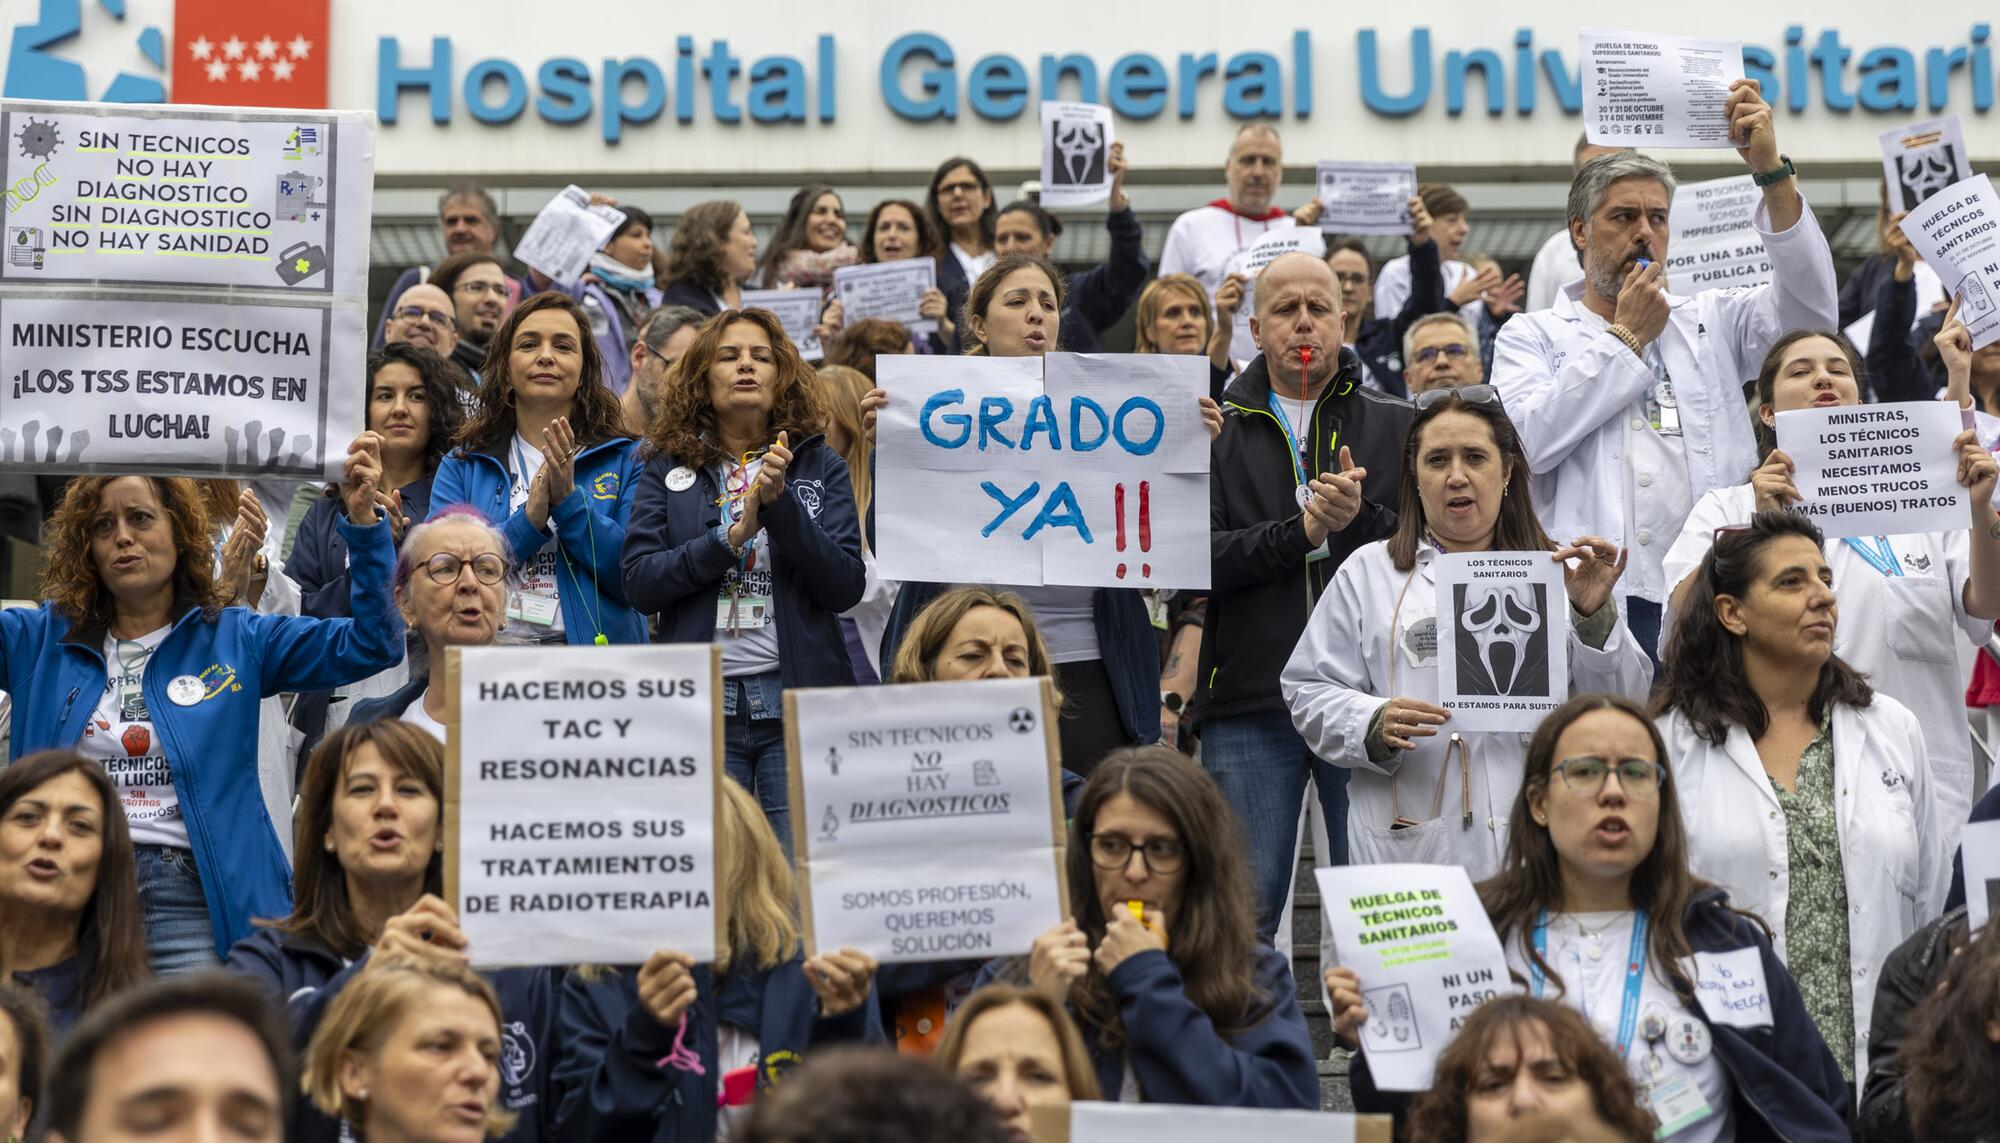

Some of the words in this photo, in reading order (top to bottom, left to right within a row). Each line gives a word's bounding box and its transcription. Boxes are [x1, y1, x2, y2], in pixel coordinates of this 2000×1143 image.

[378, 35, 836, 145] Hospital
[880, 30, 1313, 121] General
[1357, 22, 2000, 122] Univsitari
[1634, 104, 1664, 112] OCTUBRE
[79, 131, 119, 149] SIN
[128, 133, 250, 155] TECNICOS
[117, 158, 153, 176] NO
[163, 160, 213, 179] HAY
[77, 180, 248, 203] DIAGNOSTICO
[1696, 189, 1712, 199] NO
[1715, 182, 1754, 196] SOMOS
[1697, 195, 1754, 211] INVISIBLES
[1921, 201, 1964, 231] HUELGA
[1964, 193, 1980, 209] DE
[52, 204, 91, 222] SIN
[101, 205, 272, 229] DIAGNOSTICO
[1708, 208, 1749, 221] SOMOS
[1682, 220, 1753, 239] IMPRESCINDI
[1936, 219, 1998, 258] SANITARIOS
[52, 229, 89, 248] NO
[99, 231, 150, 250] HAY
[158, 233, 269, 255] SANIDAD
[1666, 256, 1695, 269] POR
[1700, 250, 1731, 263] UNA
[1984, 262, 1999, 275] NI
[1692, 264, 1756, 283] PUBLICA
[1760, 262, 1774, 273] D
[12, 323, 173, 349] MINISTERIO
[181, 327, 311, 356] ESCUCHA
[13, 369, 74, 399] ¡LOS
[82, 370, 130, 394] TSS
[136, 370, 265, 400] ESTAMOS
[272, 377, 307, 402] EN
[109, 413, 209, 440] LUCHA!
[919, 388, 1165, 456] GRADO
[1828, 410, 1909, 425] MINISTRAS,
[1819, 433, 1846, 444] LOS
[1849, 427, 1920, 442] TÉCNICOS
[1828, 444, 1913, 460] SANITARIOS
[1821, 462, 1921, 479] NECESITAMOS
[1817, 484, 1868, 497] MENOS
[1871, 479, 1928, 494] TRUCOS
[1797, 503, 1828, 516] MÁS
[1831, 500, 1897, 517] (BUENOS)
[1900, 496, 1956, 509] TRATOS
[1487, 558, 1533, 567] TÉCNICOS
[479, 680, 626, 701] HACEMOS
[637, 679, 696, 698] SUS
[1442, 701, 1456, 709] NO
[1458, 701, 1501, 709] ESTAMOS
[1503, 702, 1527, 710] PARA
[1529, 702, 1559, 710] SUSTO
[543, 719, 603, 739] TAC
[613, 718, 632, 738] Y
[848, 730, 883, 749] SIN
[889, 724, 993, 746] TECNICOS
[480, 756, 697, 780] RESONANCIAS
[911, 751, 942, 770] NO
[906, 773, 949, 793] HAY
[130, 790, 145, 798] SIN
[850, 792, 1010, 820] DIAGNOSTICOS
[490, 821, 622, 841] HACEMOS
[632, 820, 685, 838] SUS
[482, 855, 695, 877] TRATAMIENTOS
[465, 896, 500, 913] DE
[510, 891, 710, 913] RADIOTERAPIA
[842, 890, 913, 910] SOMOS
[918, 880, 1031, 905] PROFESIÓN,
[1350, 891, 1418, 910] HUELGA
[1420, 889, 1441, 901] DE
[885, 908, 994, 933] QUEREMOS
[1360, 905, 1443, 926] TÉCNICOS
[1358, 920, 1458, 945] SANITARIOS
[891, 931, 992, 956] SOLUCIÓN
[1442, 973, 1461, 988] NI
[1466, 968, 1493, 984] UN
[1448, 989, 1497, 1008] PASO
